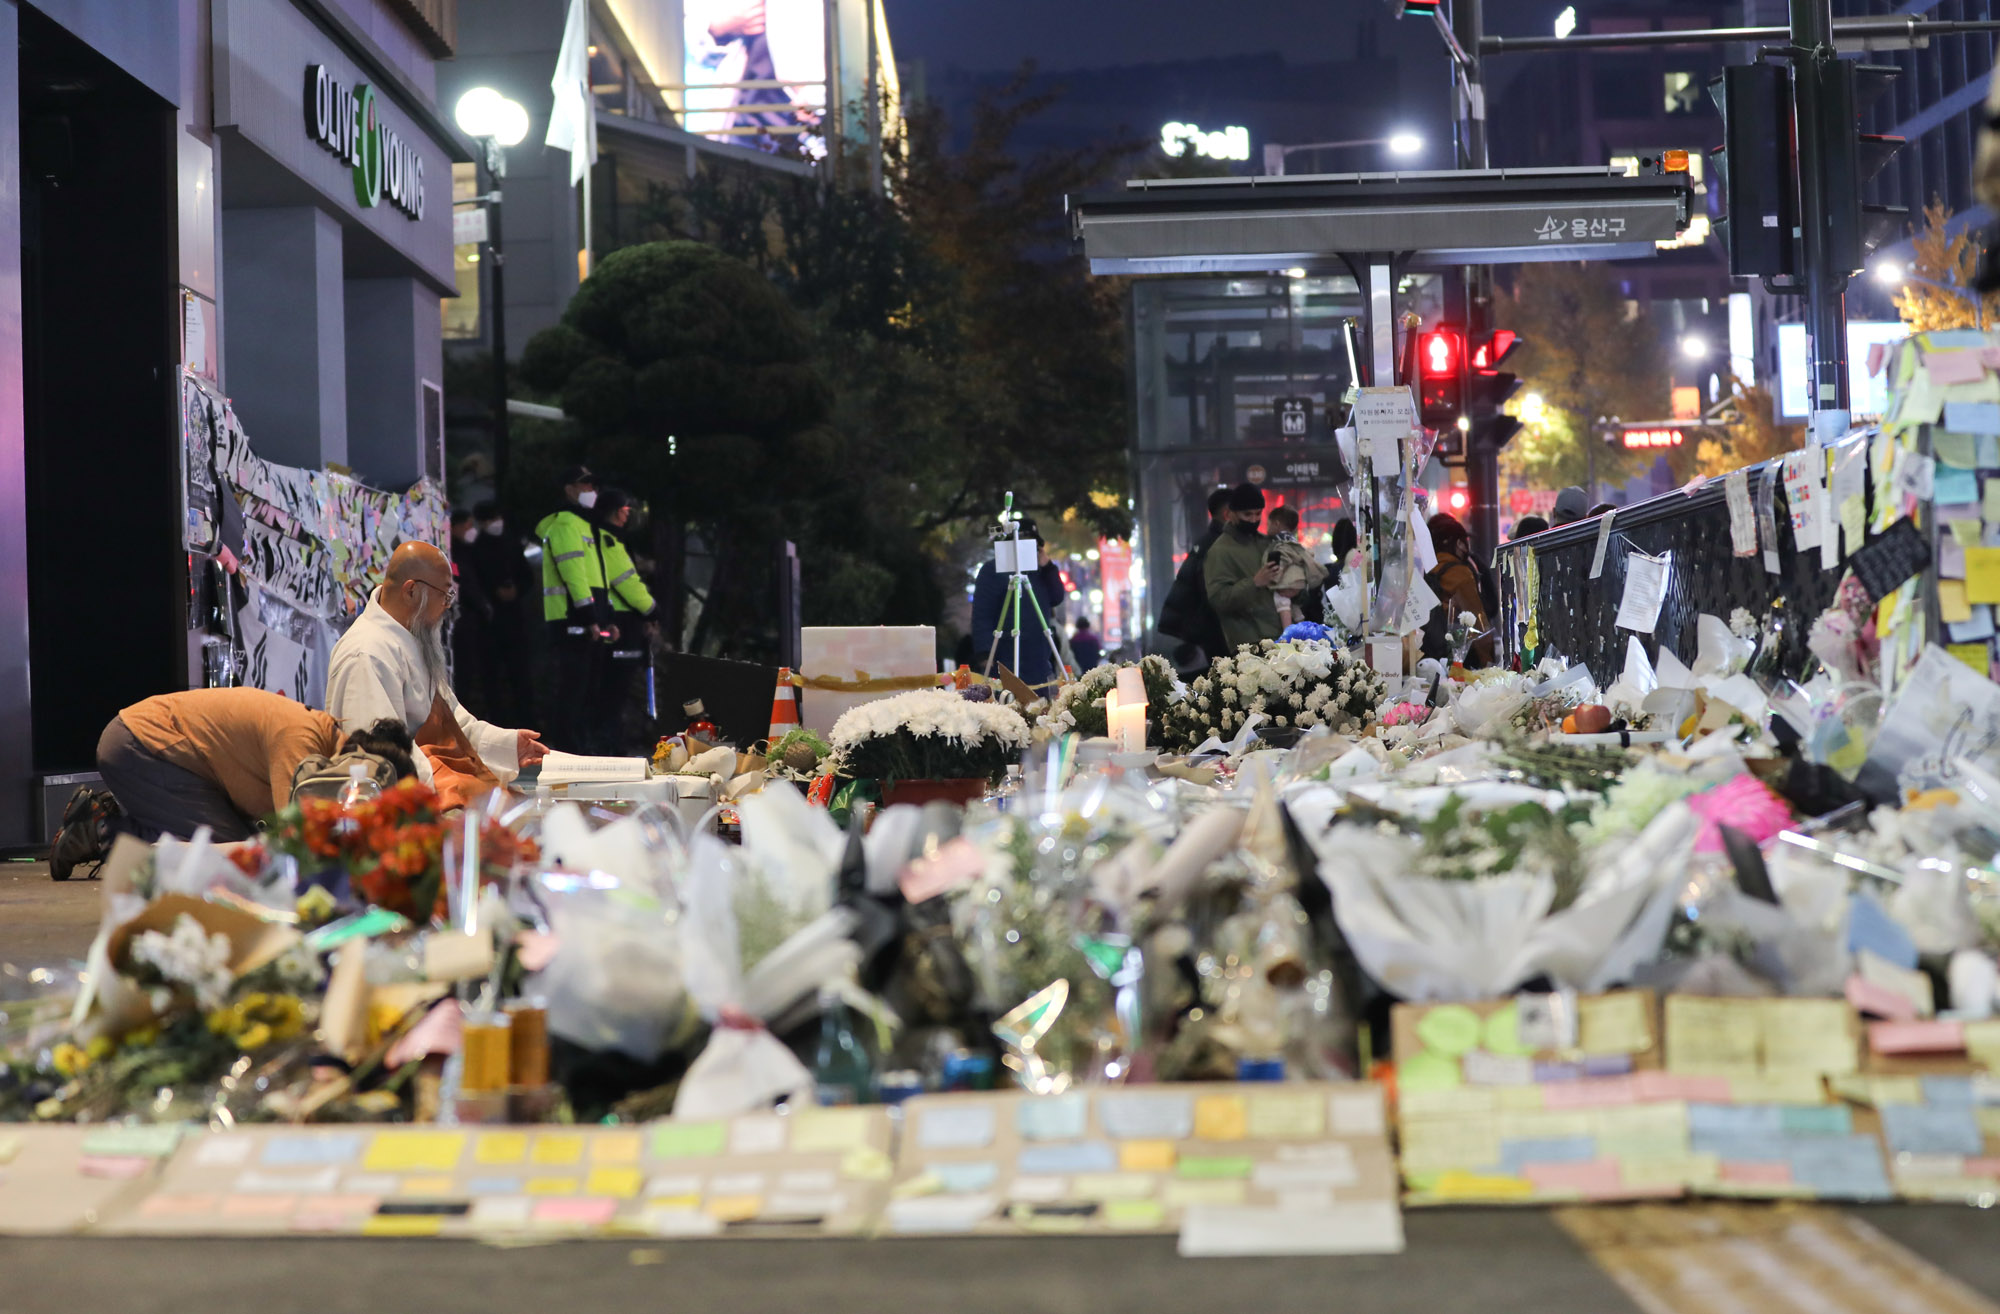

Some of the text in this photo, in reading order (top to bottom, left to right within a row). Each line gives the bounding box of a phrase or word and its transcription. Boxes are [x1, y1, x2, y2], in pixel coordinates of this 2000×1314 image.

[315, 64, 425, 222] OLIVE YOUNG
[1571, 218, 1627, 238] 용산구
[1286, 462, 1319, 476] 이태원
